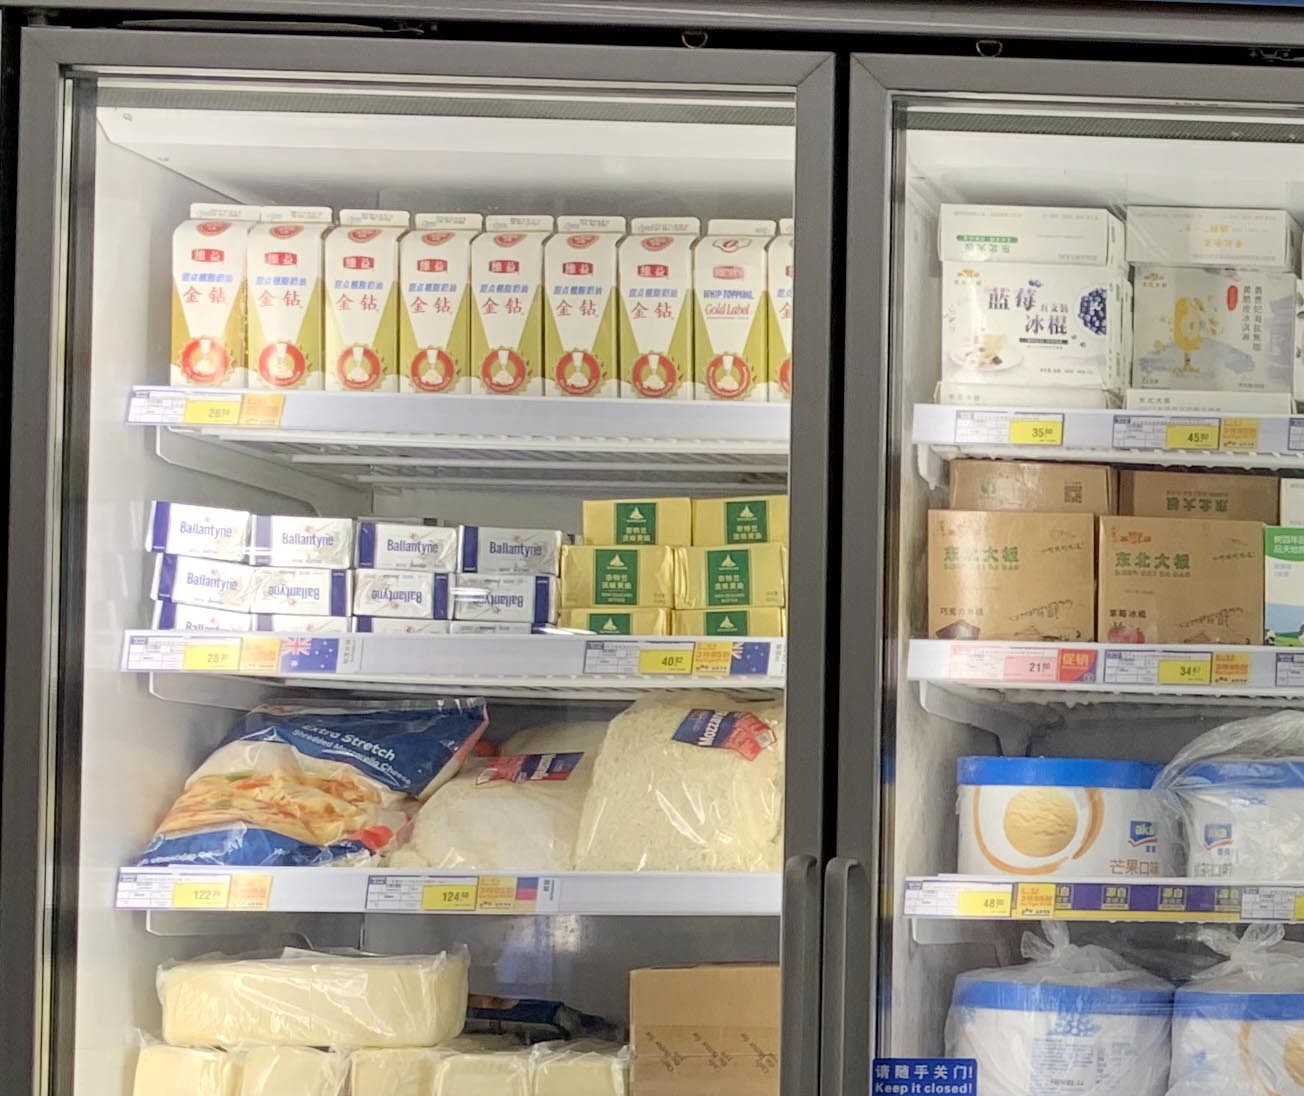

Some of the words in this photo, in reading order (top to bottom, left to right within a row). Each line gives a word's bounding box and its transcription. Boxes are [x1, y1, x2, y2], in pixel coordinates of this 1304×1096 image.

[336, 294, 377, 311] 金钻
[410, 298, 451, 313] 金钻
[482, 298, 523, 315] 金钻
[988, 288, 1038, 311] 蓝莓
[556, 300, 596, 316] 金钻
[631, 302, 672, 319] 金钻
[1024, 315, 1068, 335] 冰棍
[180, 521, 233, 538] Ballantyne
[282, 532, 334, 547] Ballantyne
[387, 539, 438, 553] Ballantyne
[489, 542, 542, 556] Ballantyne
[1115, 552, 1191, 569] 东北大板
[187, 573, 238, 590] Ballantyne
[268, 585, 320, 599] Ballantyne
[372, 589, 422, 603] Ballantyne
[1110, 860, 1160, 875] 芒果口味
[875, 1065, 972, 1079] 请随手关门!
[875, 1083, 908, 1095] Keep
[911, 1083, 922, 1093] it
[925, 1082, 972, 1094] closed!
